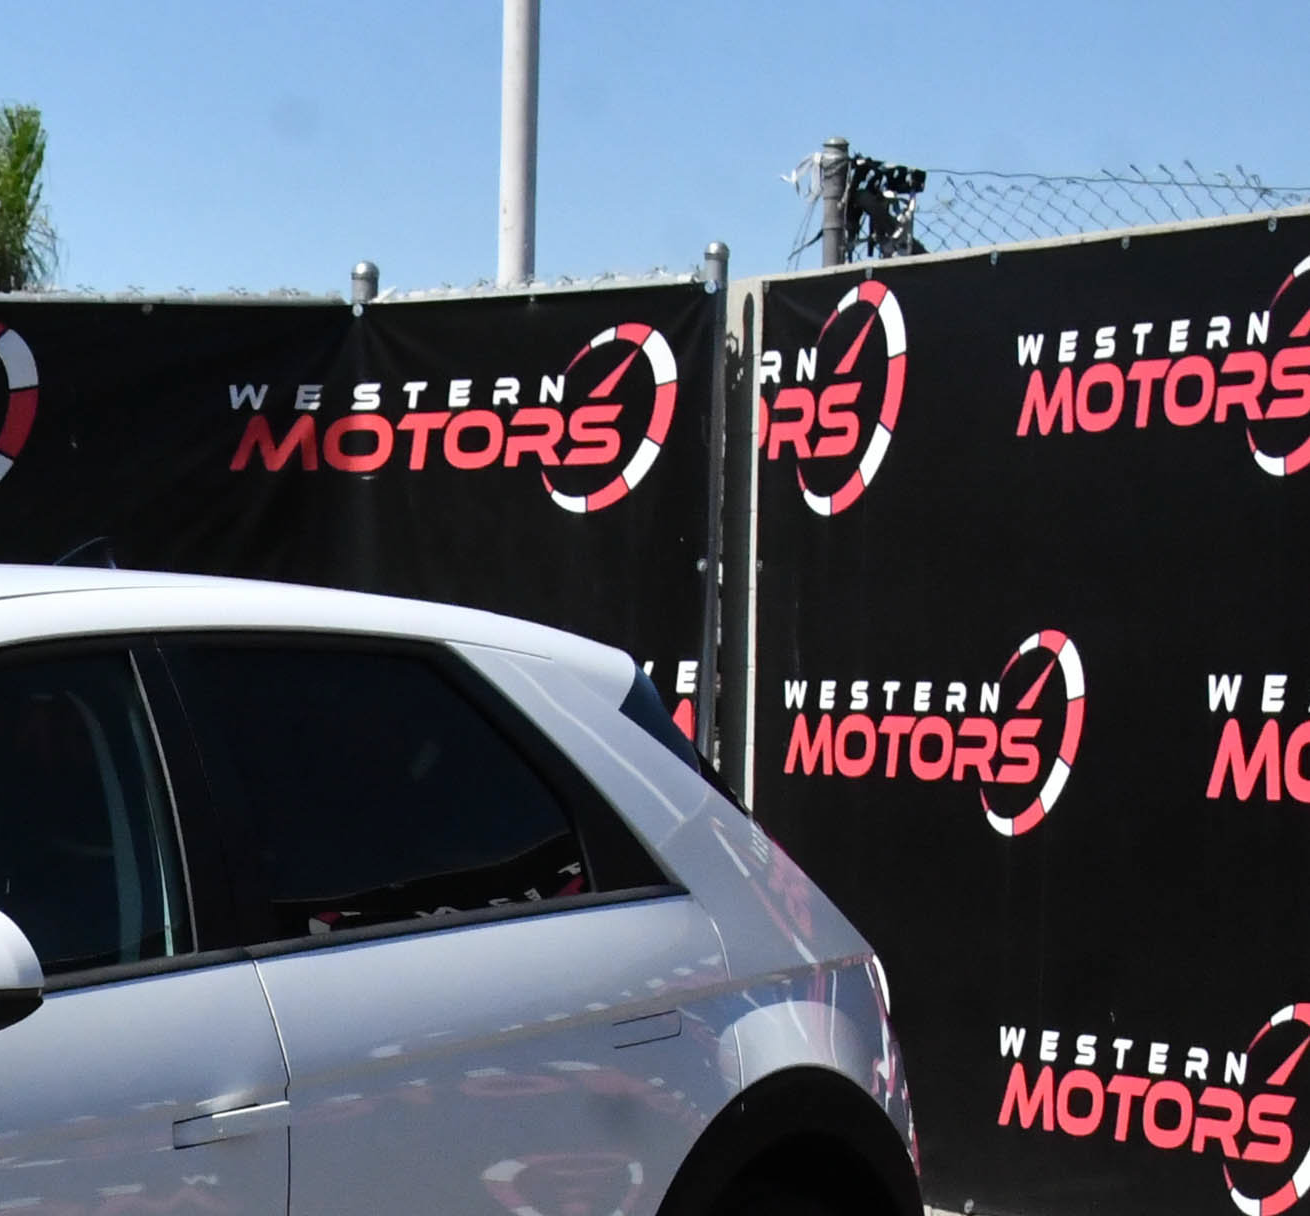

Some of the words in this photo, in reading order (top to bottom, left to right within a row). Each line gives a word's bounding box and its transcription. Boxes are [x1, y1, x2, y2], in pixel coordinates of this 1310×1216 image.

[1018, 310, 1270, 366] WESTERN
[229, 375, 565, 411] WESTERN
[1016, 345, 1310, 437] MOTORS
[230, 404, 623, 472] MOTORS
[785, 680, 1000, 713] WESTERN
[784, 713, 1043, 783] MOTORS
[999, 1026, 1247, 1085] WESTERN
[998, 1062, 1296, 1164] MOTORS
